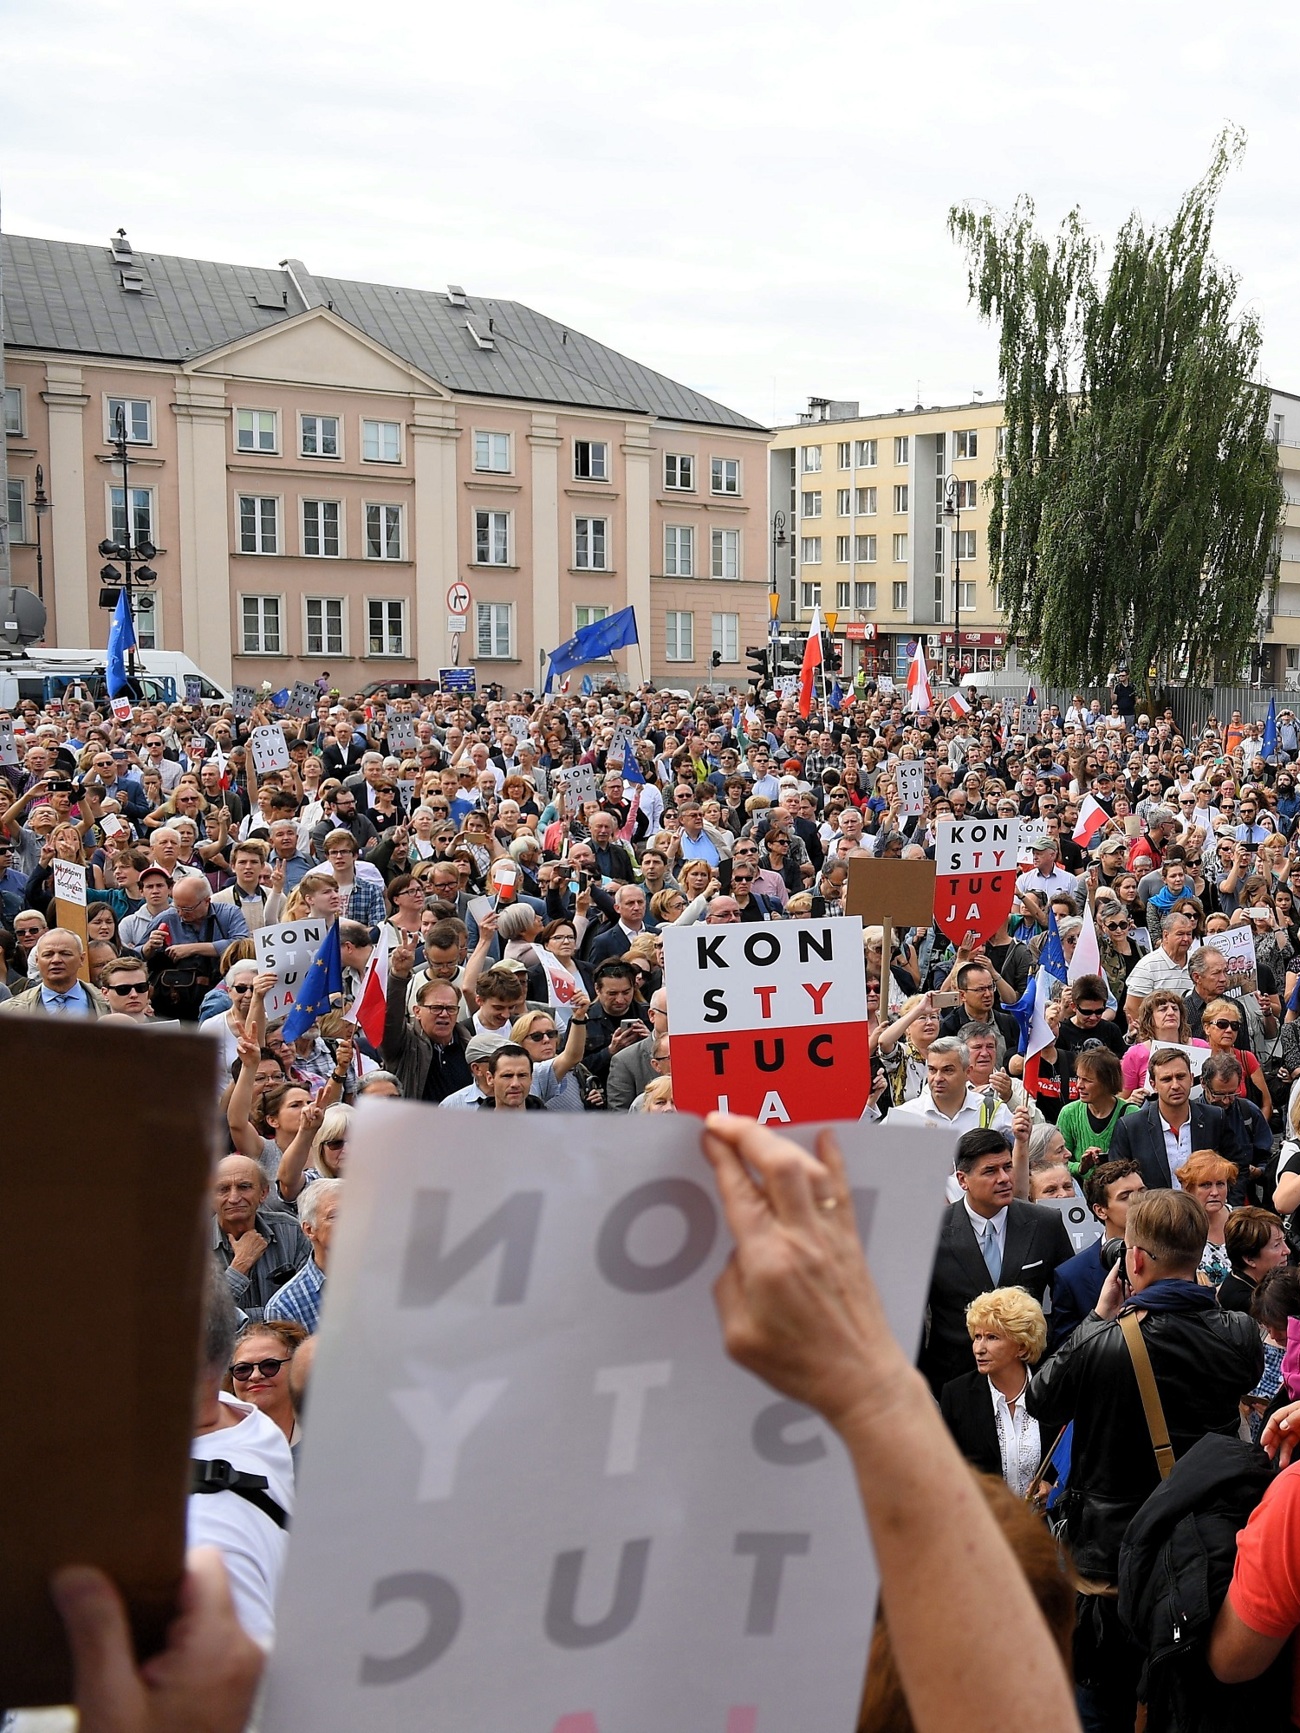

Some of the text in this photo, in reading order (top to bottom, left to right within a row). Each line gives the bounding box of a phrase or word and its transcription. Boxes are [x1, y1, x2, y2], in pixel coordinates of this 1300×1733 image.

[296, 684, 316, 695] KON
[294, 691, 313, 702] STY
[292, 699, 311, 709] TUC
[390, 723, 411, 731] STY
[619, 727, 638, 737] KON
[253, 728, 280, 739] KON
[255, 738, 280, 748] STY
[258, 747, 284, 758] TUC
[261, 760, 277, 768] JA
[564, 768, 590, 780] KON
[900, 767, 923, 777] KON
[568, 785, 591, 796] TUC
[570, 796, 583, 805] JA
[904, 803, 920, 811] JA
[951, 824, 1008, 843] KON
[950, 850, 1005, 870] STY
[950, 876, 1002, 896] TUC
[946, 903, 980, 922] JA
[262, 928, 319, 948] KON
[1232, 932, 1250, 945] PiC
[697, 929, 833, 969] KON
[555, 980, 568, 988] JA
[273, 991, 294, 1010] JA
[703, 982, 833, 1023] STY
[706, 1034, 834, 1075] TUC
